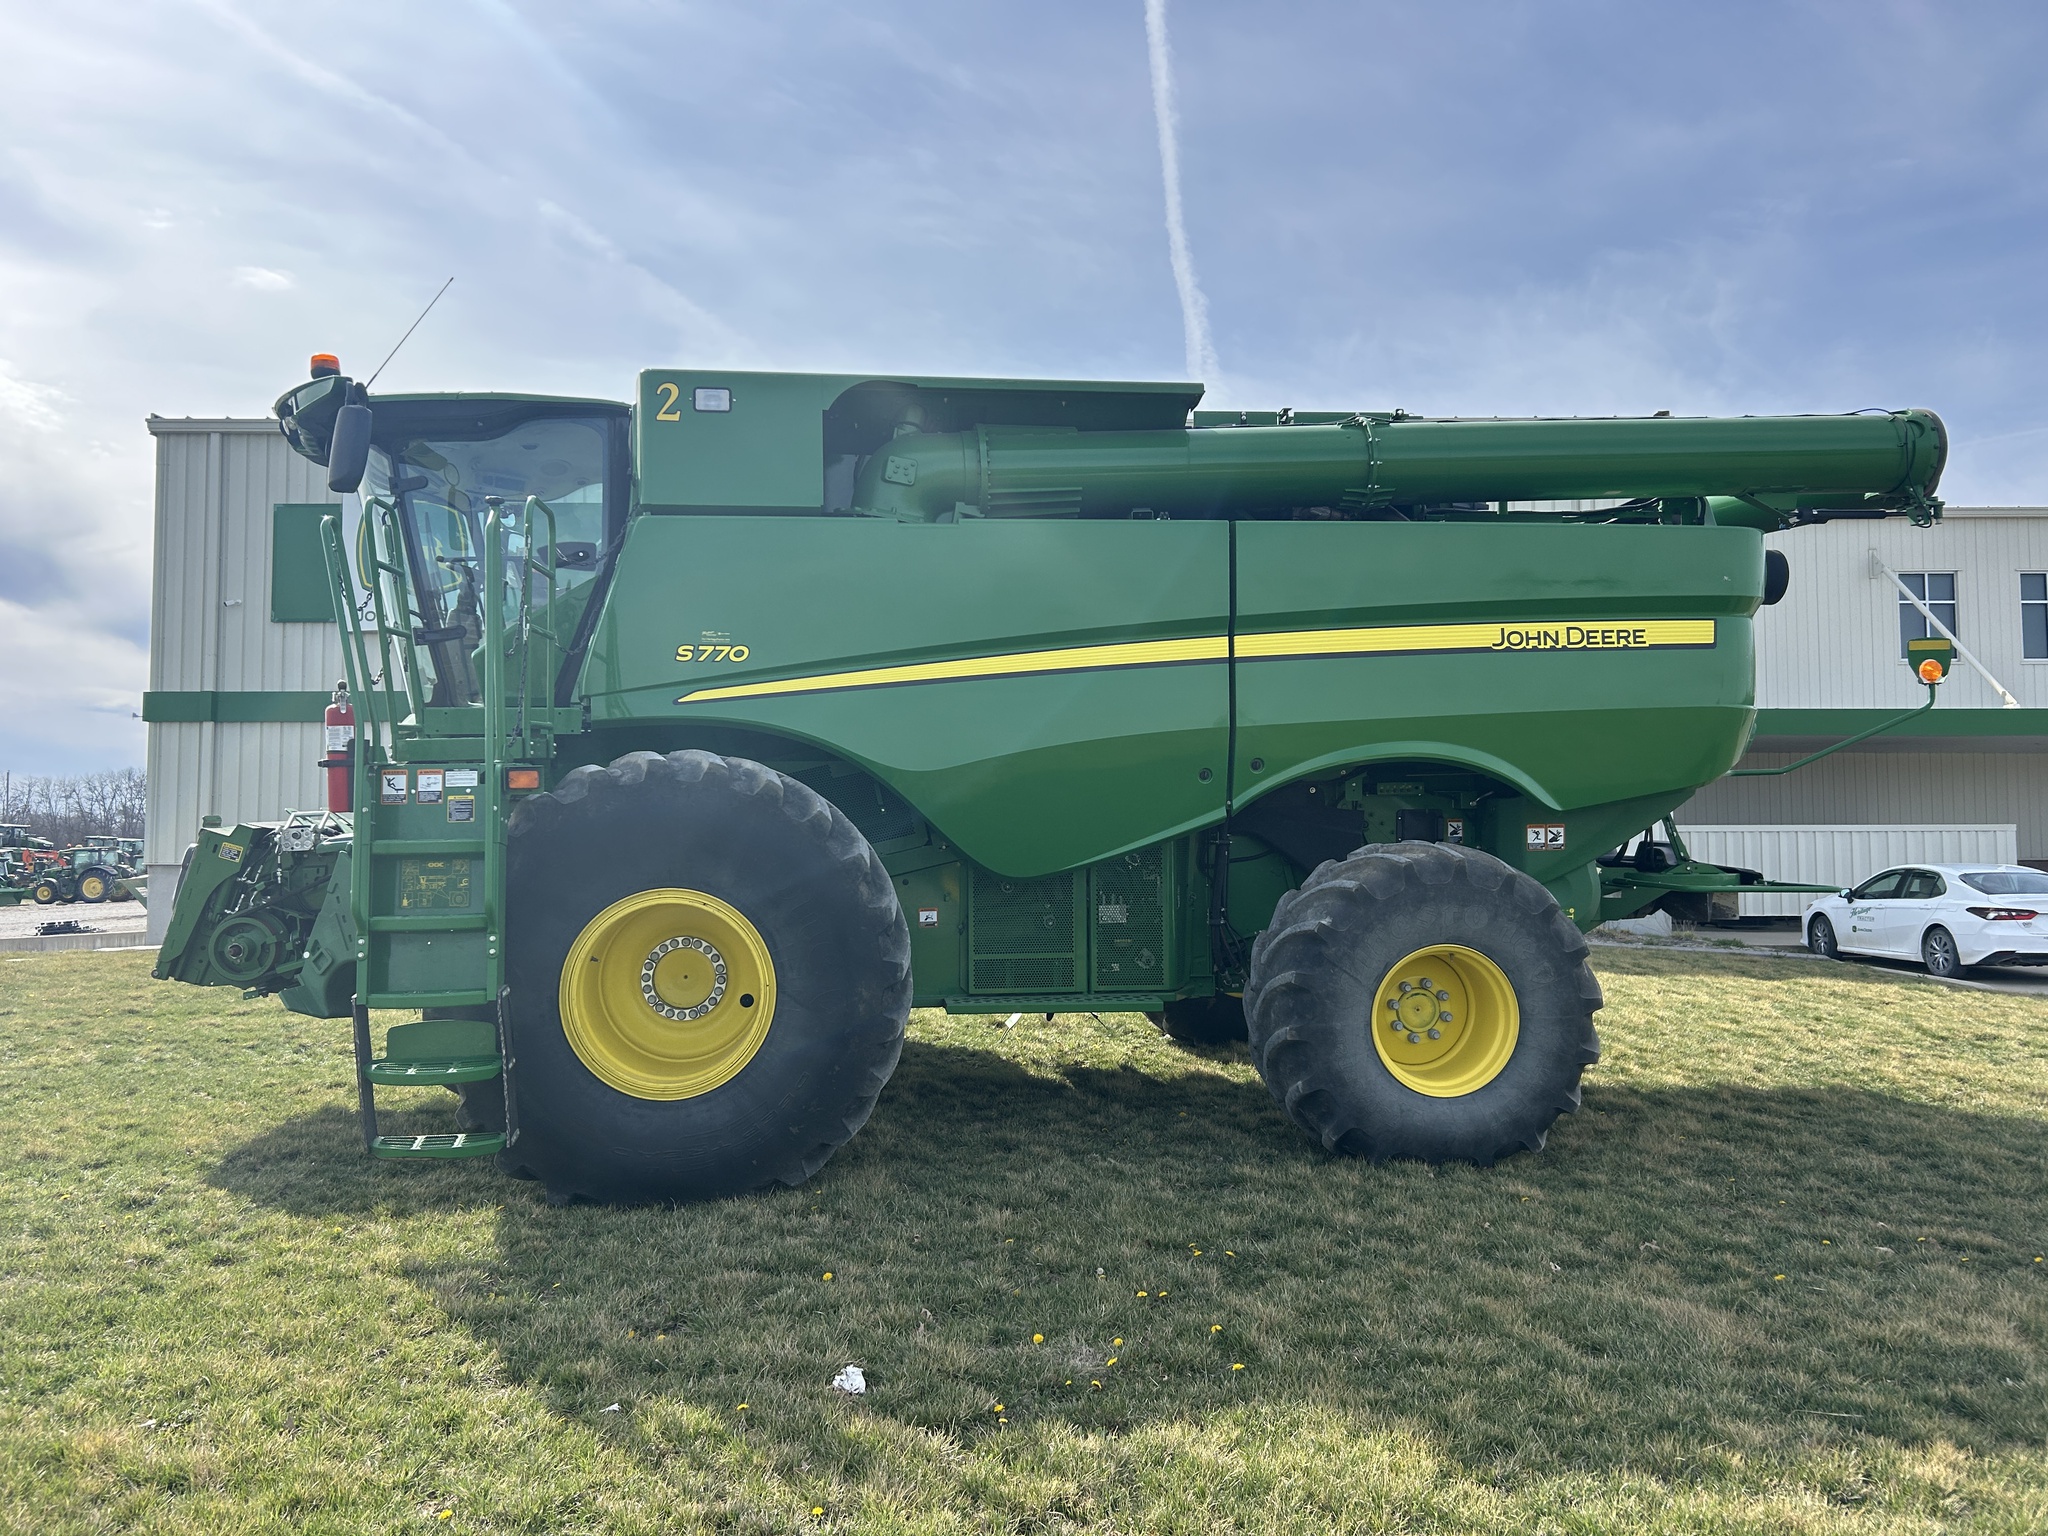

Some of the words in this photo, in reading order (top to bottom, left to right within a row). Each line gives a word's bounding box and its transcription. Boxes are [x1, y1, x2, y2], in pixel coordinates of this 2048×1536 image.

[655, 381, 682, 422] 2
[1492, 627, 1559, 647] JOHN
[1566, 627, 1647, 646] DEERE
[674, 644, 750, 662] S770
